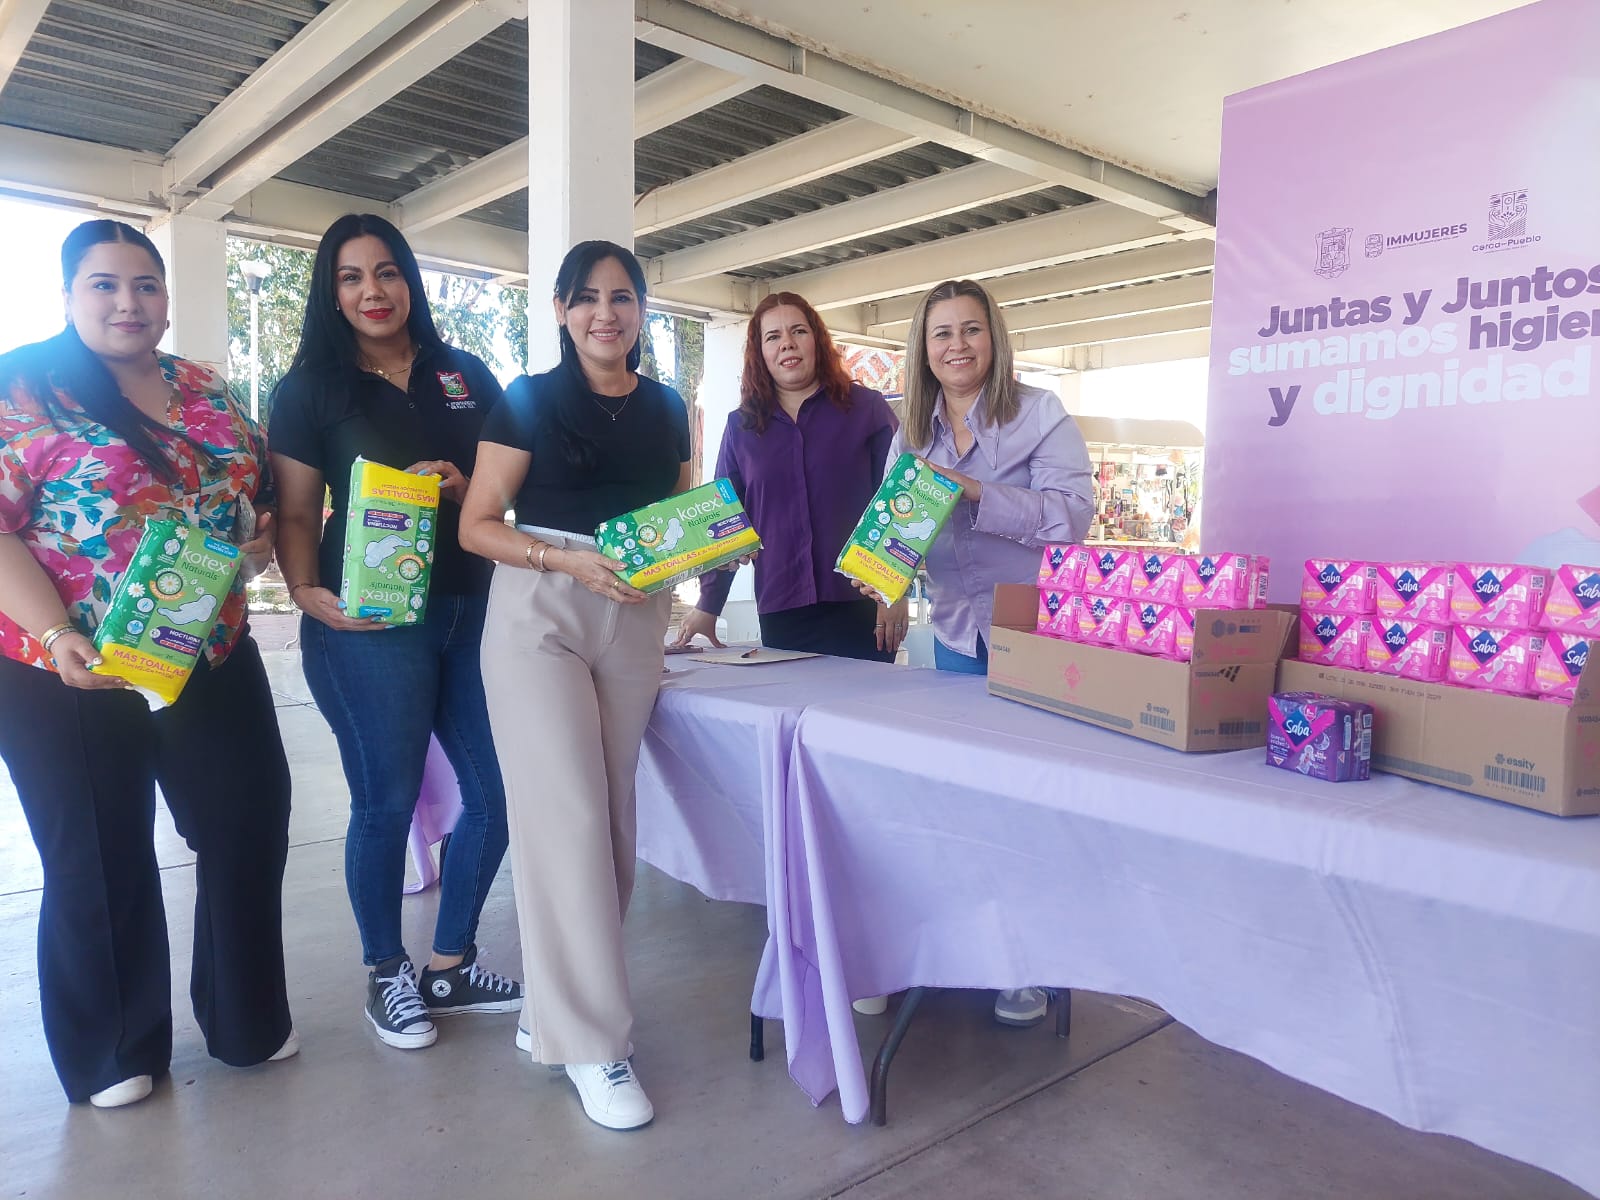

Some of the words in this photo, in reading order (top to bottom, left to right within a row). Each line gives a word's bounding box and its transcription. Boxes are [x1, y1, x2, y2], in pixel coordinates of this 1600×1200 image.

[1386, 223, 1468, 247] IMMUJERES
[1258, 295, 1391, 338] Juntas
[1402, 289, 1433, 325] y
[1227, 322, 1458, 376] sumamos
[1268, 385, 1301, 427] y
[1312, 345, 1592, 420] dignidad
[372, 487, 416, 500] TOALLAS
[915, 474, 949, 505] kotex
[675, 497, 721, 522] kotex
[687, 511, 721, 528] Naturals
[181, 544, 228, 576] kotex
[662, 551, 697, 569] TOALLAS
[1099, 559, 1115, 570] Saba
[1145, 561, 1163, 573] Saba
[181, 561, 220, 581] Naturals
[873, 559, 905, 584] TOALLAS
[1199, 563, 1216, 576] Saba
[1320, 571, 1341, 583] Saba
[370, 581, 405, 592] Naturals
[1396, 578, 1419, 592] Saba
[1475, 579, 1500, 593] Saba
[1575, 582, 1600, 599] Sab
[364, 588, 409, 607] kotex
[1142, 611, 1157, 623] Saba
[1316, 622, 1338, 637] Saba
[1385, 631, 1406, 645] Saba
[1471, 639, 1497, 654] Saba
[140, 656, 187, 678] TOALLAS
[1564, 650, 1588, 667] Sab
[1285, 719, 1310, 737] Saba
[1506, 757, 1536, 772] essity
